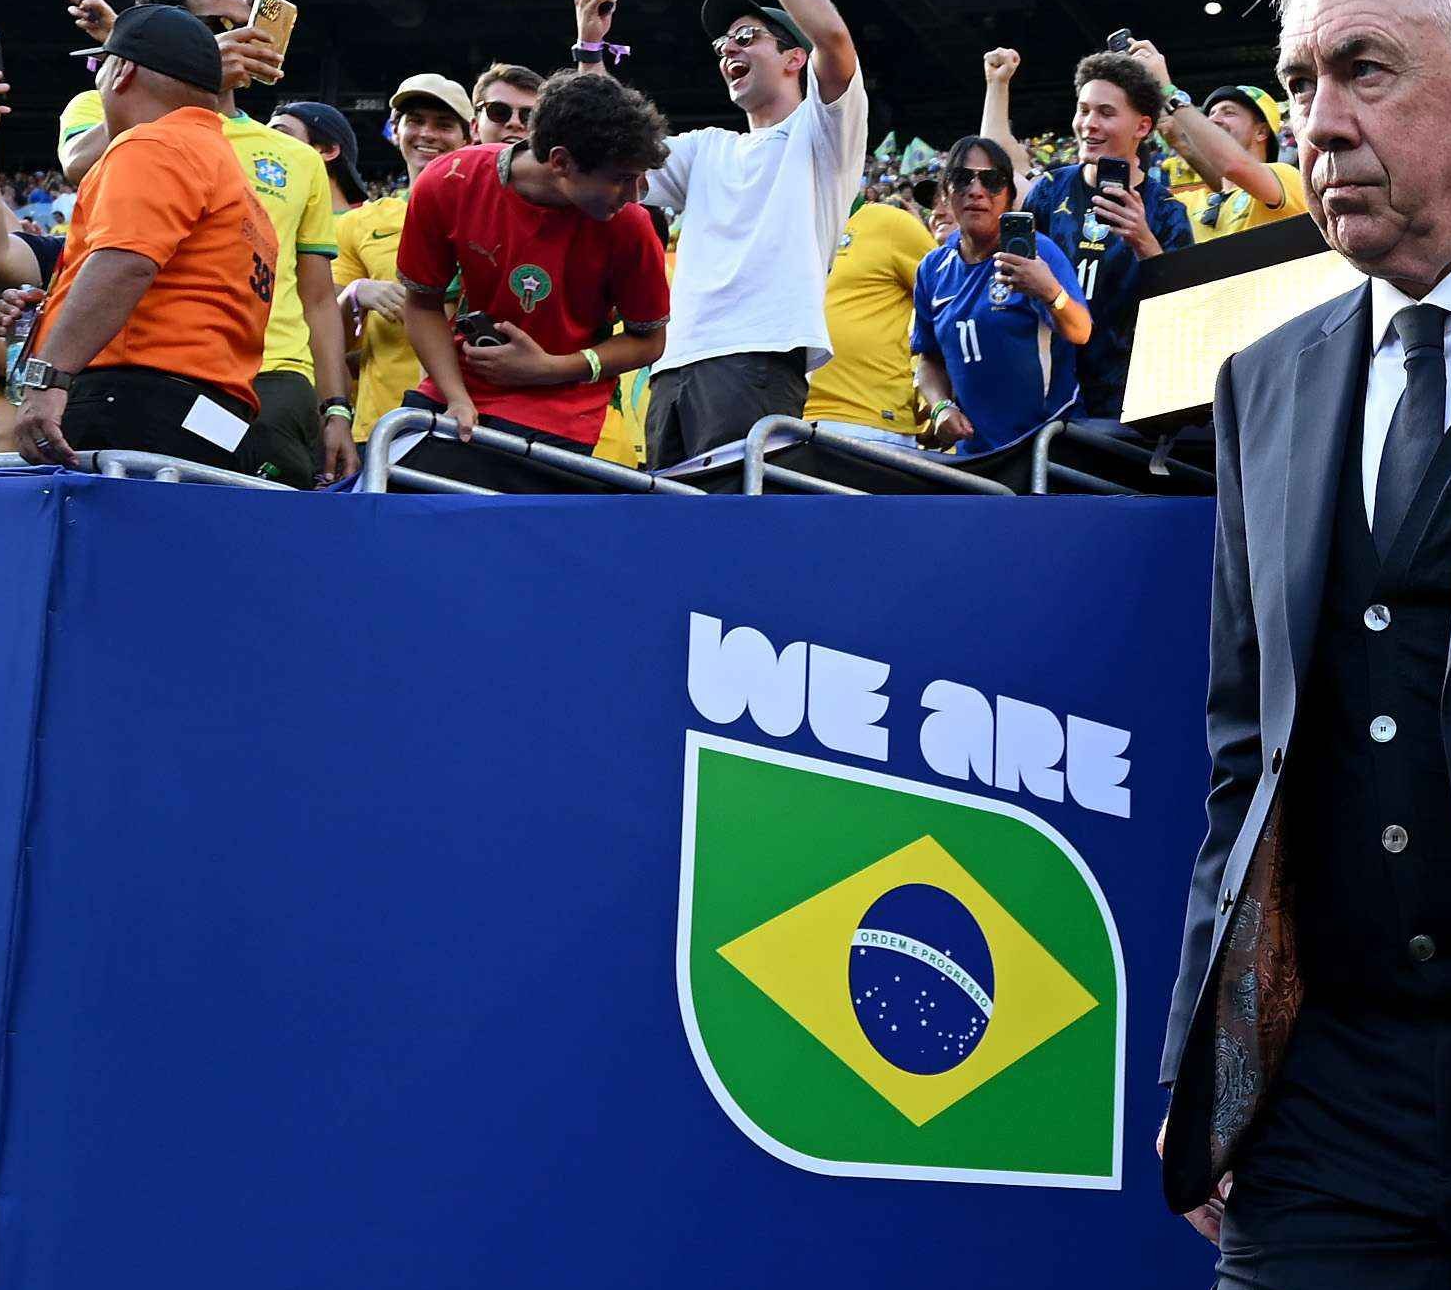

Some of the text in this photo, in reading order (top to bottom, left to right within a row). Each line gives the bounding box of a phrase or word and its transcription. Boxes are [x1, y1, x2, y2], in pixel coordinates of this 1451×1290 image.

[1077, 258, 1099, 300] 11
[956, 318, 982, 363] 11
[687, 611, 891, 762] WE
[861, 932, 989, 1008] ORDEM E PROGRESSO
